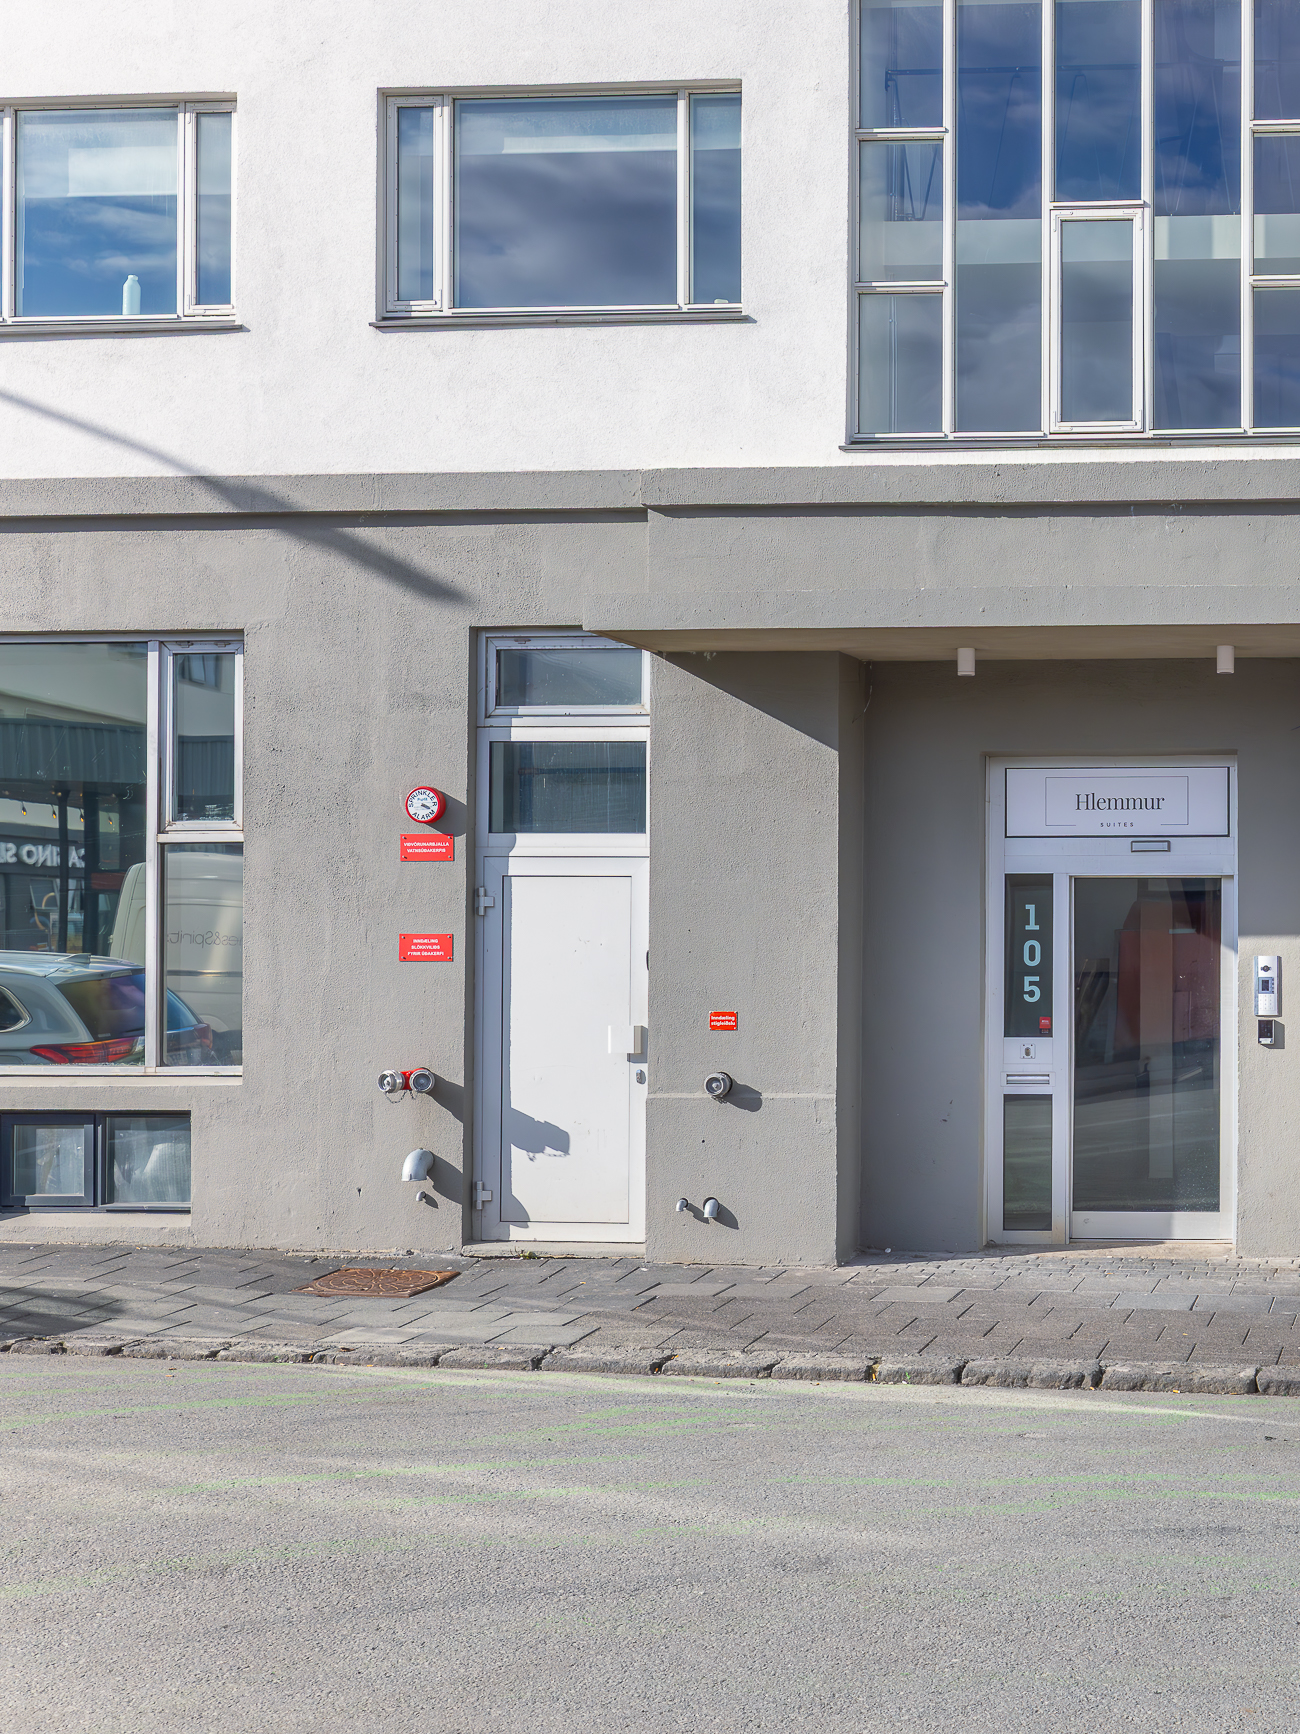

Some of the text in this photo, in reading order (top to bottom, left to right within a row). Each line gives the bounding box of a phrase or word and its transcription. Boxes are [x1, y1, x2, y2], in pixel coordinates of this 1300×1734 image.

[408, 790, 438, 808] SPRINKLER
[1075, 792, 1165, 811] Hlemmur
[412, 809, 436, 820] ALARM
